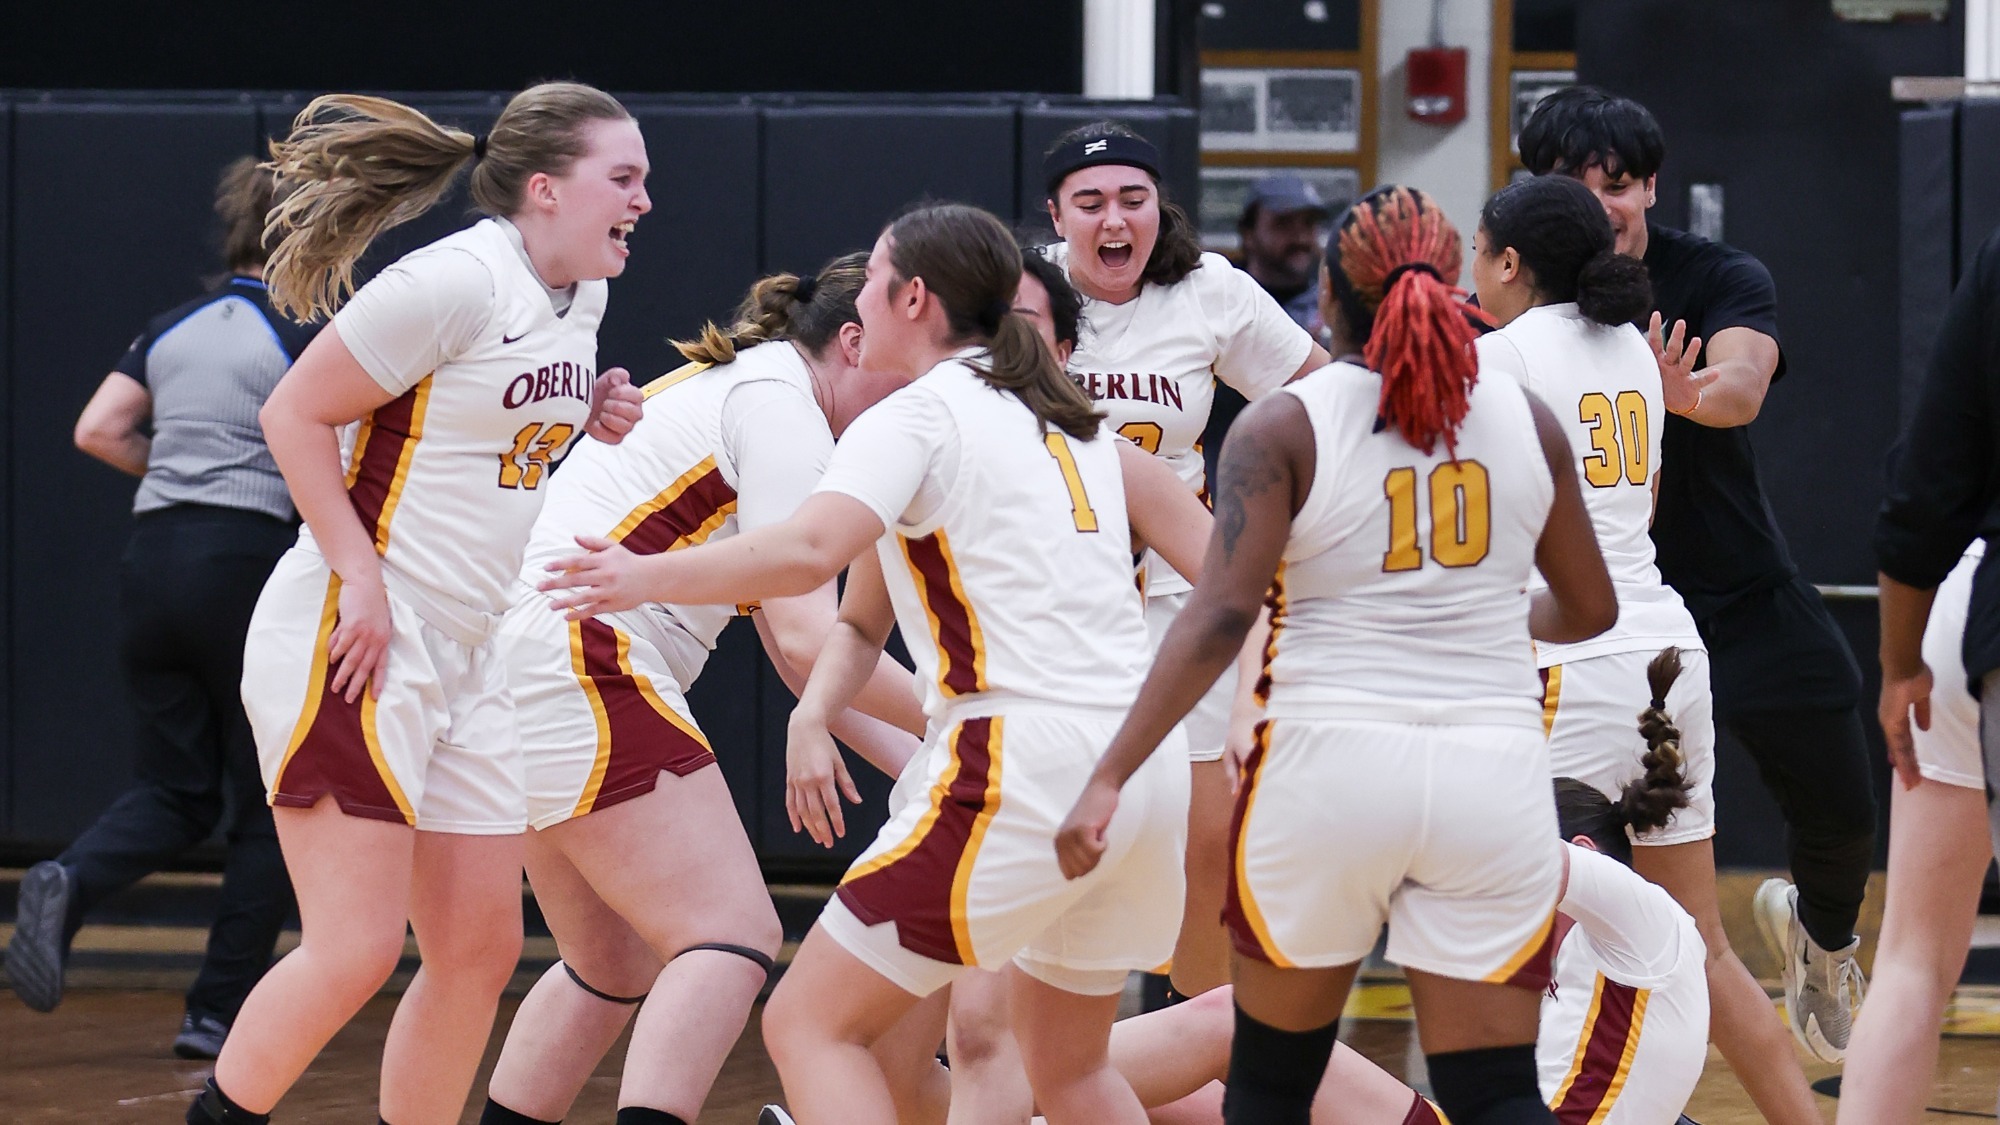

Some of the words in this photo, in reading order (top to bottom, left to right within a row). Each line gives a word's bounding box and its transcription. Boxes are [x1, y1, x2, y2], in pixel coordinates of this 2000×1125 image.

[1044, 432, 1099, 533] 1
[1579, 390, 1649, 488] 30
[1382, 458, 1491, 572] 10
